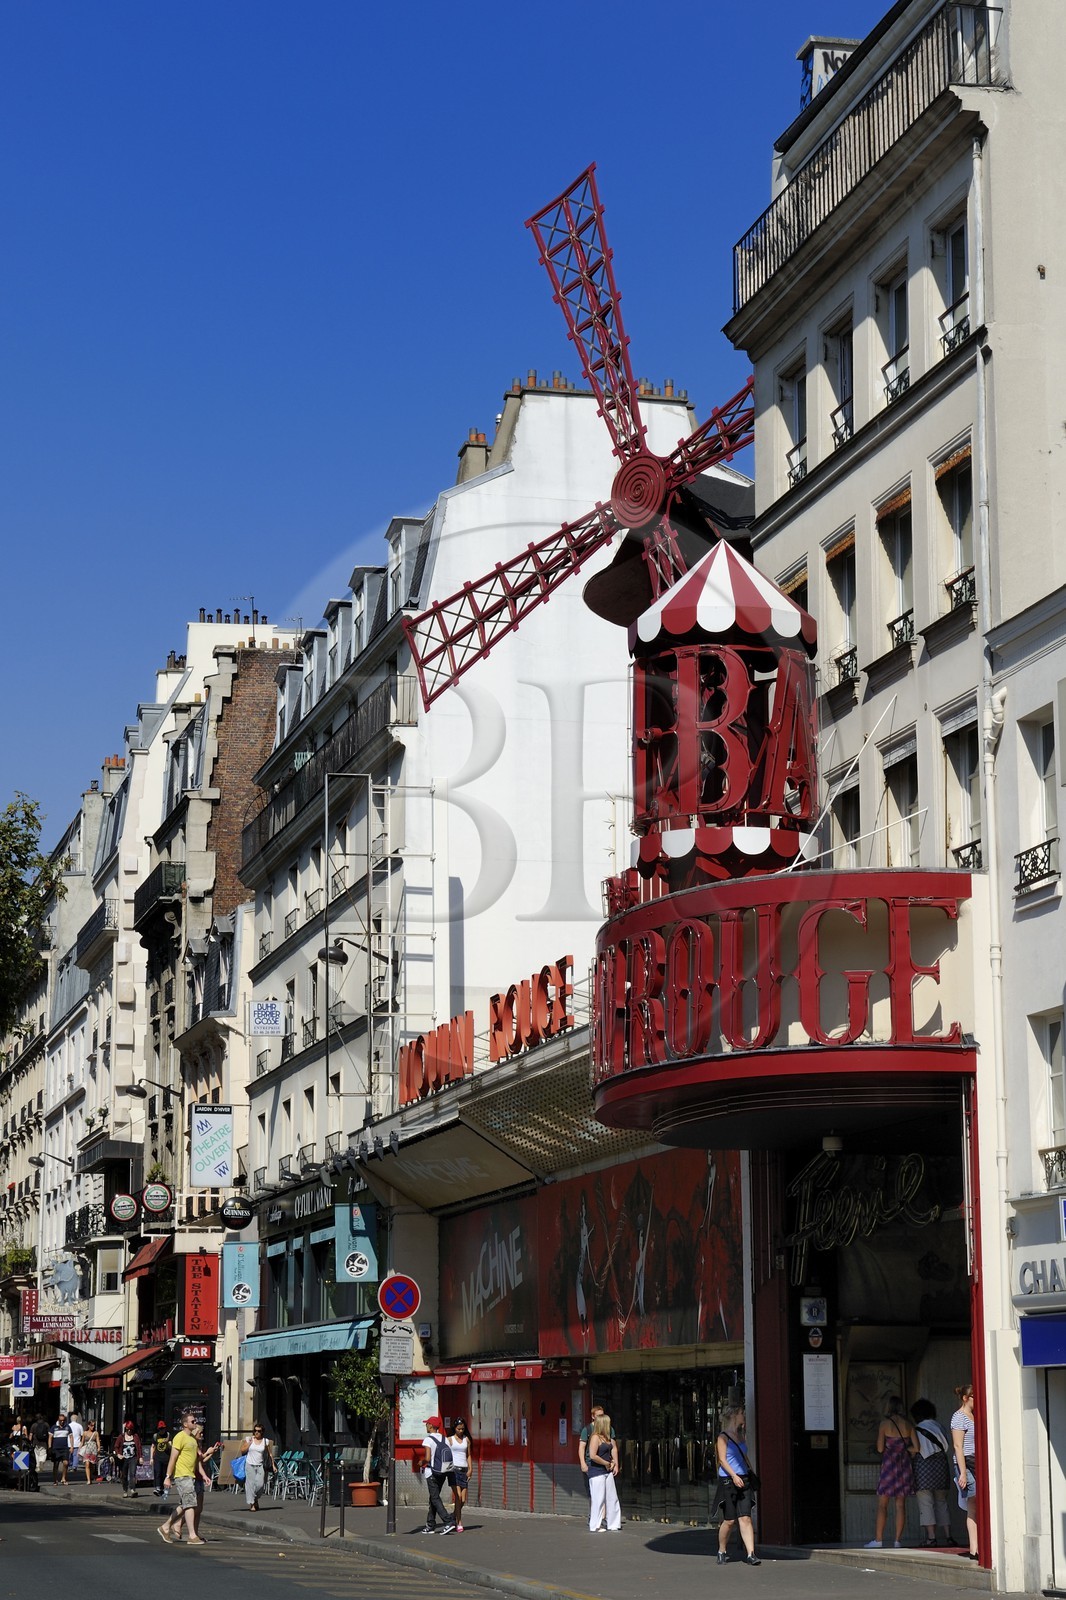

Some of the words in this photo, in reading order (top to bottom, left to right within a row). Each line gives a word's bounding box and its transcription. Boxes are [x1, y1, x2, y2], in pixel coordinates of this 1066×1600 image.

[614, 898, 963, 1076] ROUGE
[255, 1017, 279, 1025] GOSSE
[399, 1010, 475, 1105] MOULIN
[489, 955, 575, 1062] ROUGE
[193, 1123, 232, 1156] THEATRE
[194, 1140, 231, 1172] OUVERT
[223, 1208, 250, 1216] GUINNESS
[191, 1259, 203, 1279] THE
[461, 1225, 523, 1335] MACHINE
[1019, 1257, 1066, 1295] CHA
[190, 1283, 202, 1330] STATION
[62, 1329, 92, 1344] DEUX
[94, 1329, 122, 1344] ANES
[183, 1347, 208, 1357] BAR
[19, 1372, 28, 1385] P
